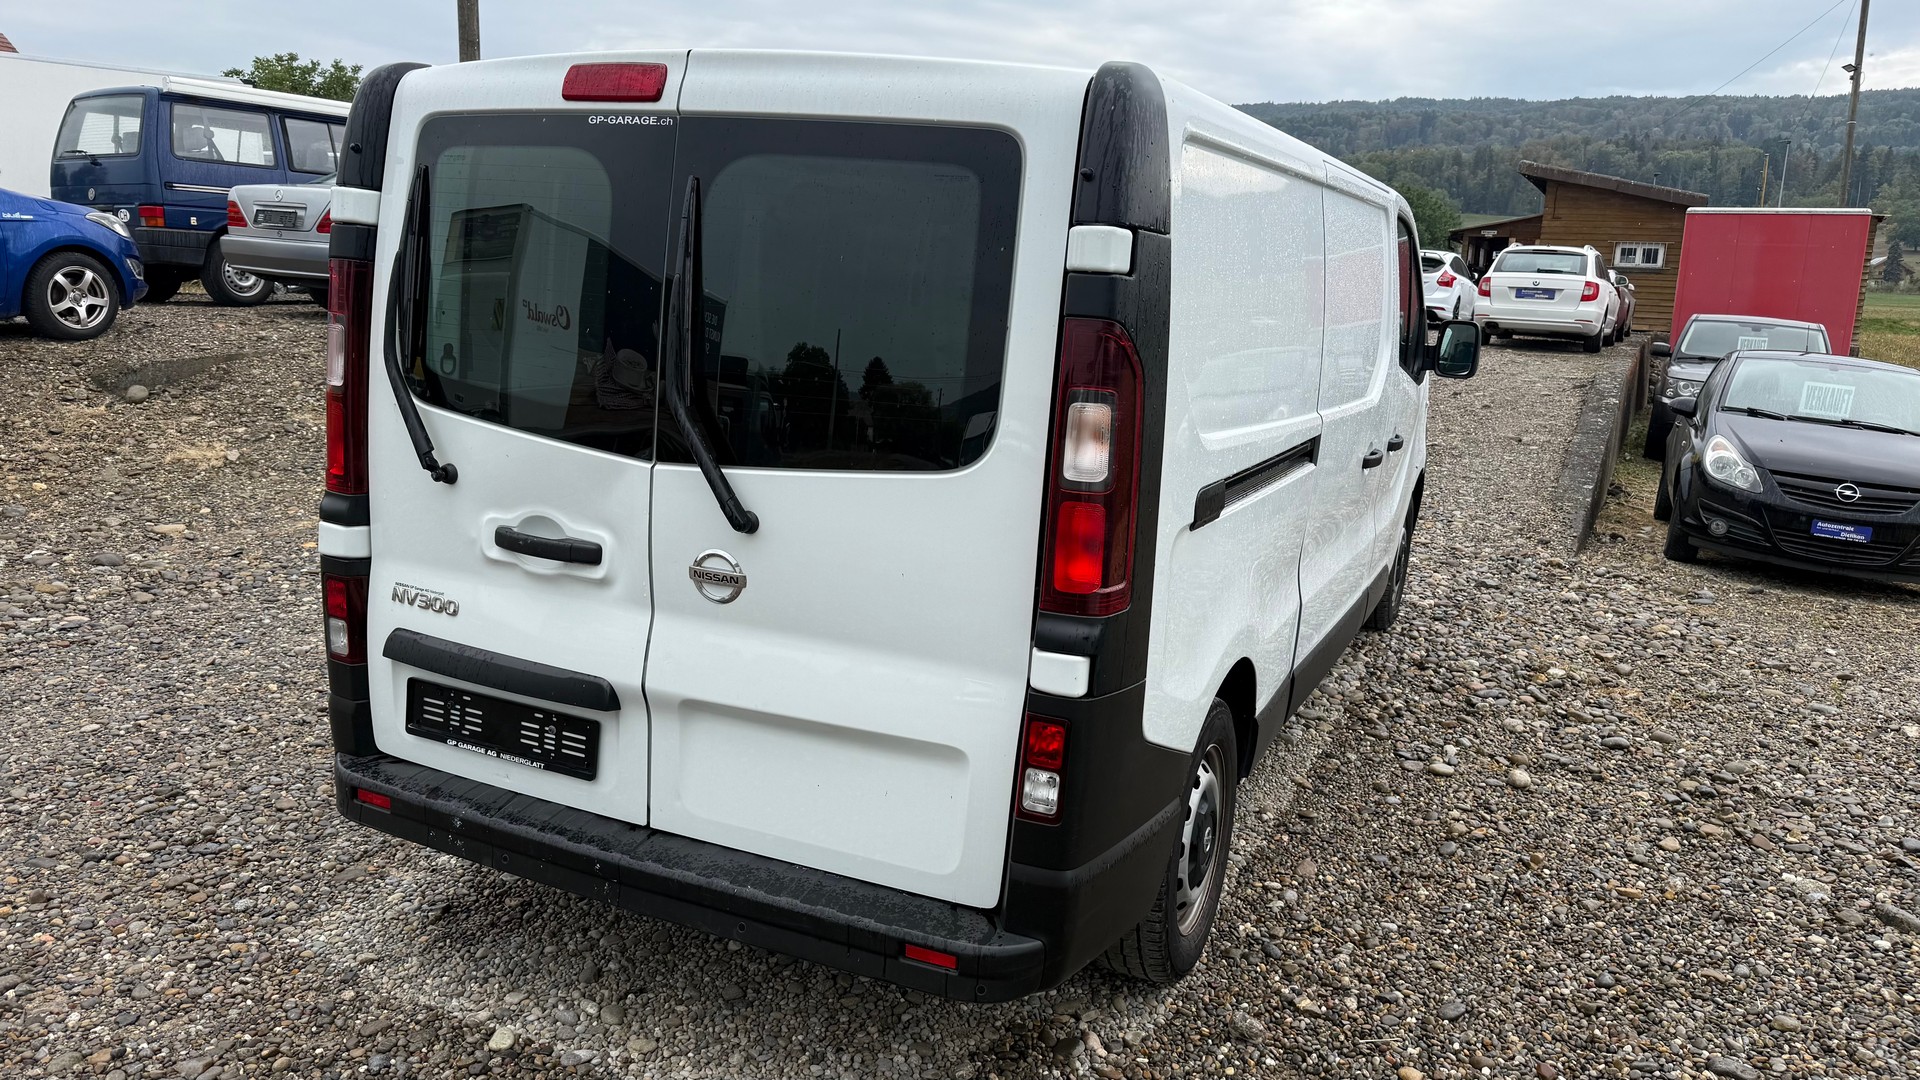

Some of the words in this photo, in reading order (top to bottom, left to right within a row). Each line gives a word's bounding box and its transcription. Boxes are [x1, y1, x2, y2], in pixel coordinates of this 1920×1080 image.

[588, 115, 673, 126] GP-GARAGE.ch
[119, 210, 128, 221] CH
[1803, 384, 1853, 415] VERKAUFT
[1817, 521, 1854, 532] Autozentrale
[693, 569, 739, 585] NISSAN
[391, 585, 460, 617] NV300
[446, 738, 457, 746] GP
[457, 741, 486, 754] GARAGE
[486, 749, 497, 757] AG
[499, 752, 545, 770] NIEDERGLATT
